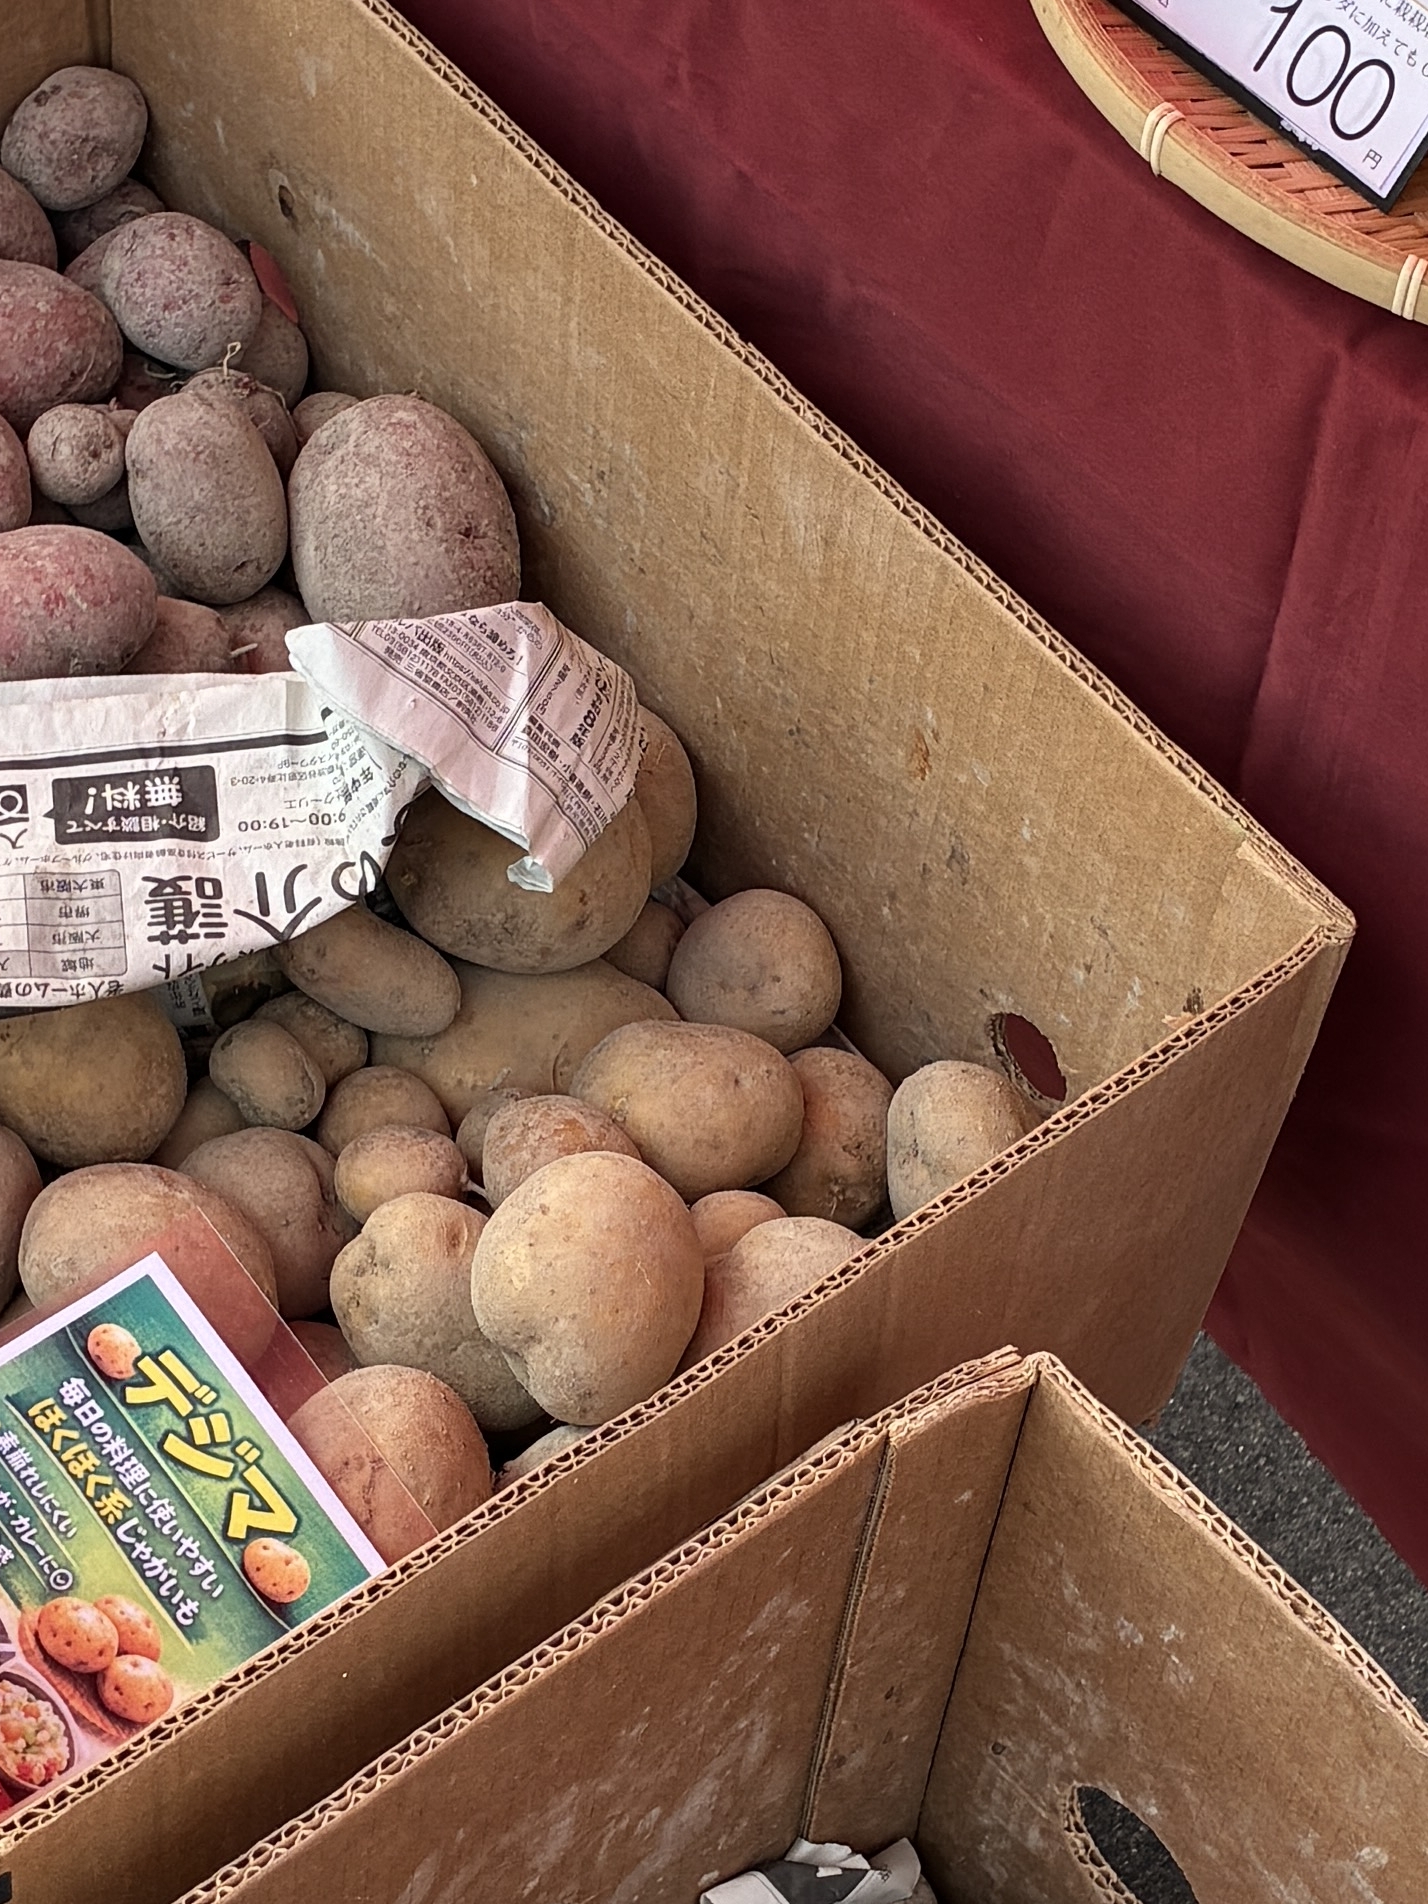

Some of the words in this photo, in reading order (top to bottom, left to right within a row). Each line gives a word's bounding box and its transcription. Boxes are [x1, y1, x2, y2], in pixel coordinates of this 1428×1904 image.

[1363, 149, 1383, 170] 円
[88, 779, 184, 815] 無料!
[66, 813, 208, 836] 紹介・相談すべて
[39, 877, 106, 894] 東大阪市
[50, 927, 102, 946] 大阪市
[60, 958, 95, 974] 地域
[124, 1349, 299, 1541] デジマ
[56, 1377, 225, 1598] 毎日の料理に使いやすい
